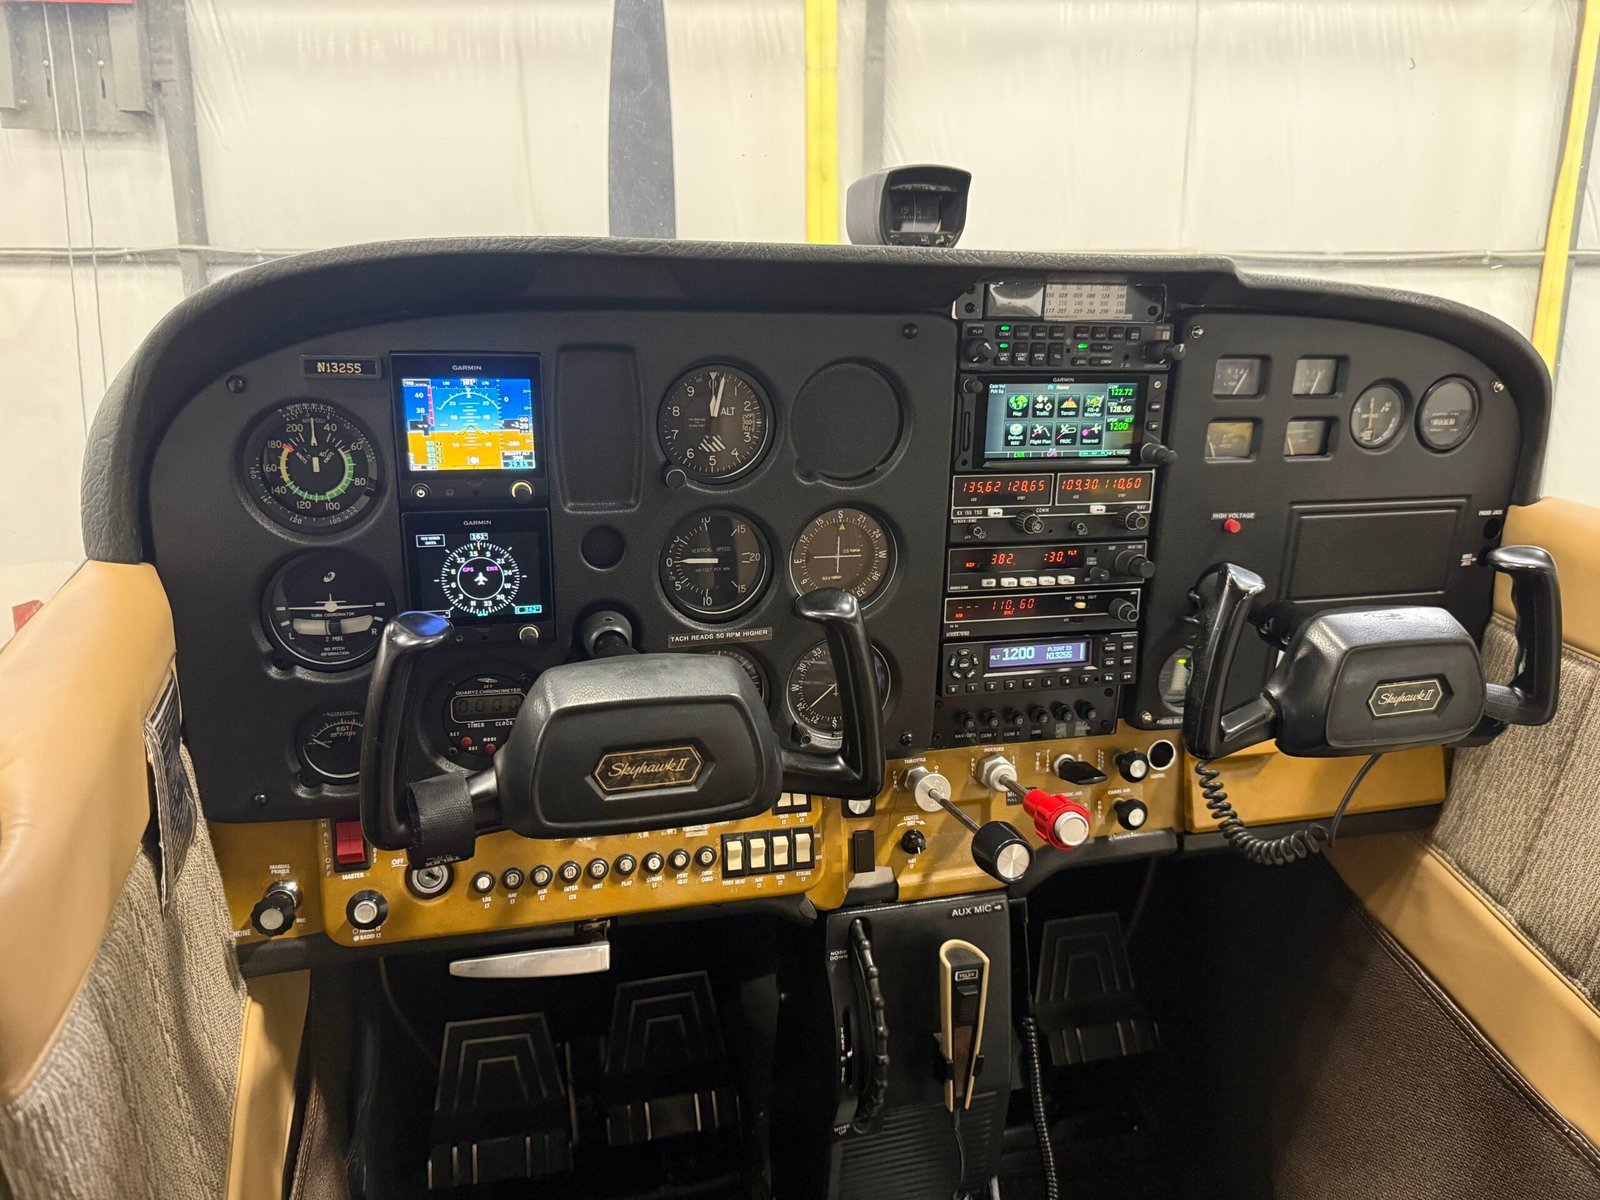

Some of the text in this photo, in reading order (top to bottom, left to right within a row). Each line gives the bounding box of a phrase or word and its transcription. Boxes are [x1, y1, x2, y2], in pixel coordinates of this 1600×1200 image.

[317, 362, 362, 373] N13255
[686, 386, 694, 396] 9
[1112, 388, 1134, 396] 122.72
[672, 406, 680, 416] 8
[744, 401, 751, 412] 2
[720, 407, 736, 416] ALT
[286, 424, 304, 432] 200
[324, 423, 337, 432] 40
[1110, 422, 1129, 430] 1200
[671, 430, 679, 440] 7
[744, 432, 751, 442] 3
[268, 440, 282, 448] 180
[350, 442, 363, 451] 60
[686, 448, 694, 458] 6
[731, 448, 739, 458] 4
[709, 456, 716, 466] 5
[263, 464, 278, 472] 160
[354, 478, 366, 486] 80
[1008, 480, 1045, 492] 128.65
[1062, 479, 1098, 490] 109.30
[1106, 478, 1142, 490] 110.60
[271, 486, 286, 494] 140
[964, 481, 1001, 494] 135.62
[296, 502, 312, 510] 120
[325, 502, 340, 510] 100
[838, 510, 844, 518] S
[858, 514, 866, 523] 21
[816, 518, 824, 527] 15
[737, 525, 746, 534] 15
[872, 528, 882, 538] 24
[800, 534, 808, 544] 12
[750, 552, 760, 562] 20
[878, 550, 887, 558] W
[666, 558, 672, 568] 0
[991, 554, 1014, 564] 382
[872, 570, 881, 580] 30
[675, 582, 682, 591] 5
[856, 588, 866, 596] 33
[702, 596, 712, 606] 10
[992, 599, 1034, 610] 110.60
[372, 628, 378, 636] R
[812, 647, 822, 656] 33
[1002, 646, 1034, 660] 1200
[797, 662, 806, 672] 30
[791, 683, 800, 692] W
[1378, 689, 1435, 706] Skyhawk II
[832, 719, 838, 728] S
[608, 758, 690, 779] Skyhawk II
[392, 858, 404, 866] OFF
[652, 859, 656, 868] 5
[342, 872, 364, 880] MASTER
[952, 904, 992, 916] AUX MIC
[834, 1124, 850, 1132] NOSE
